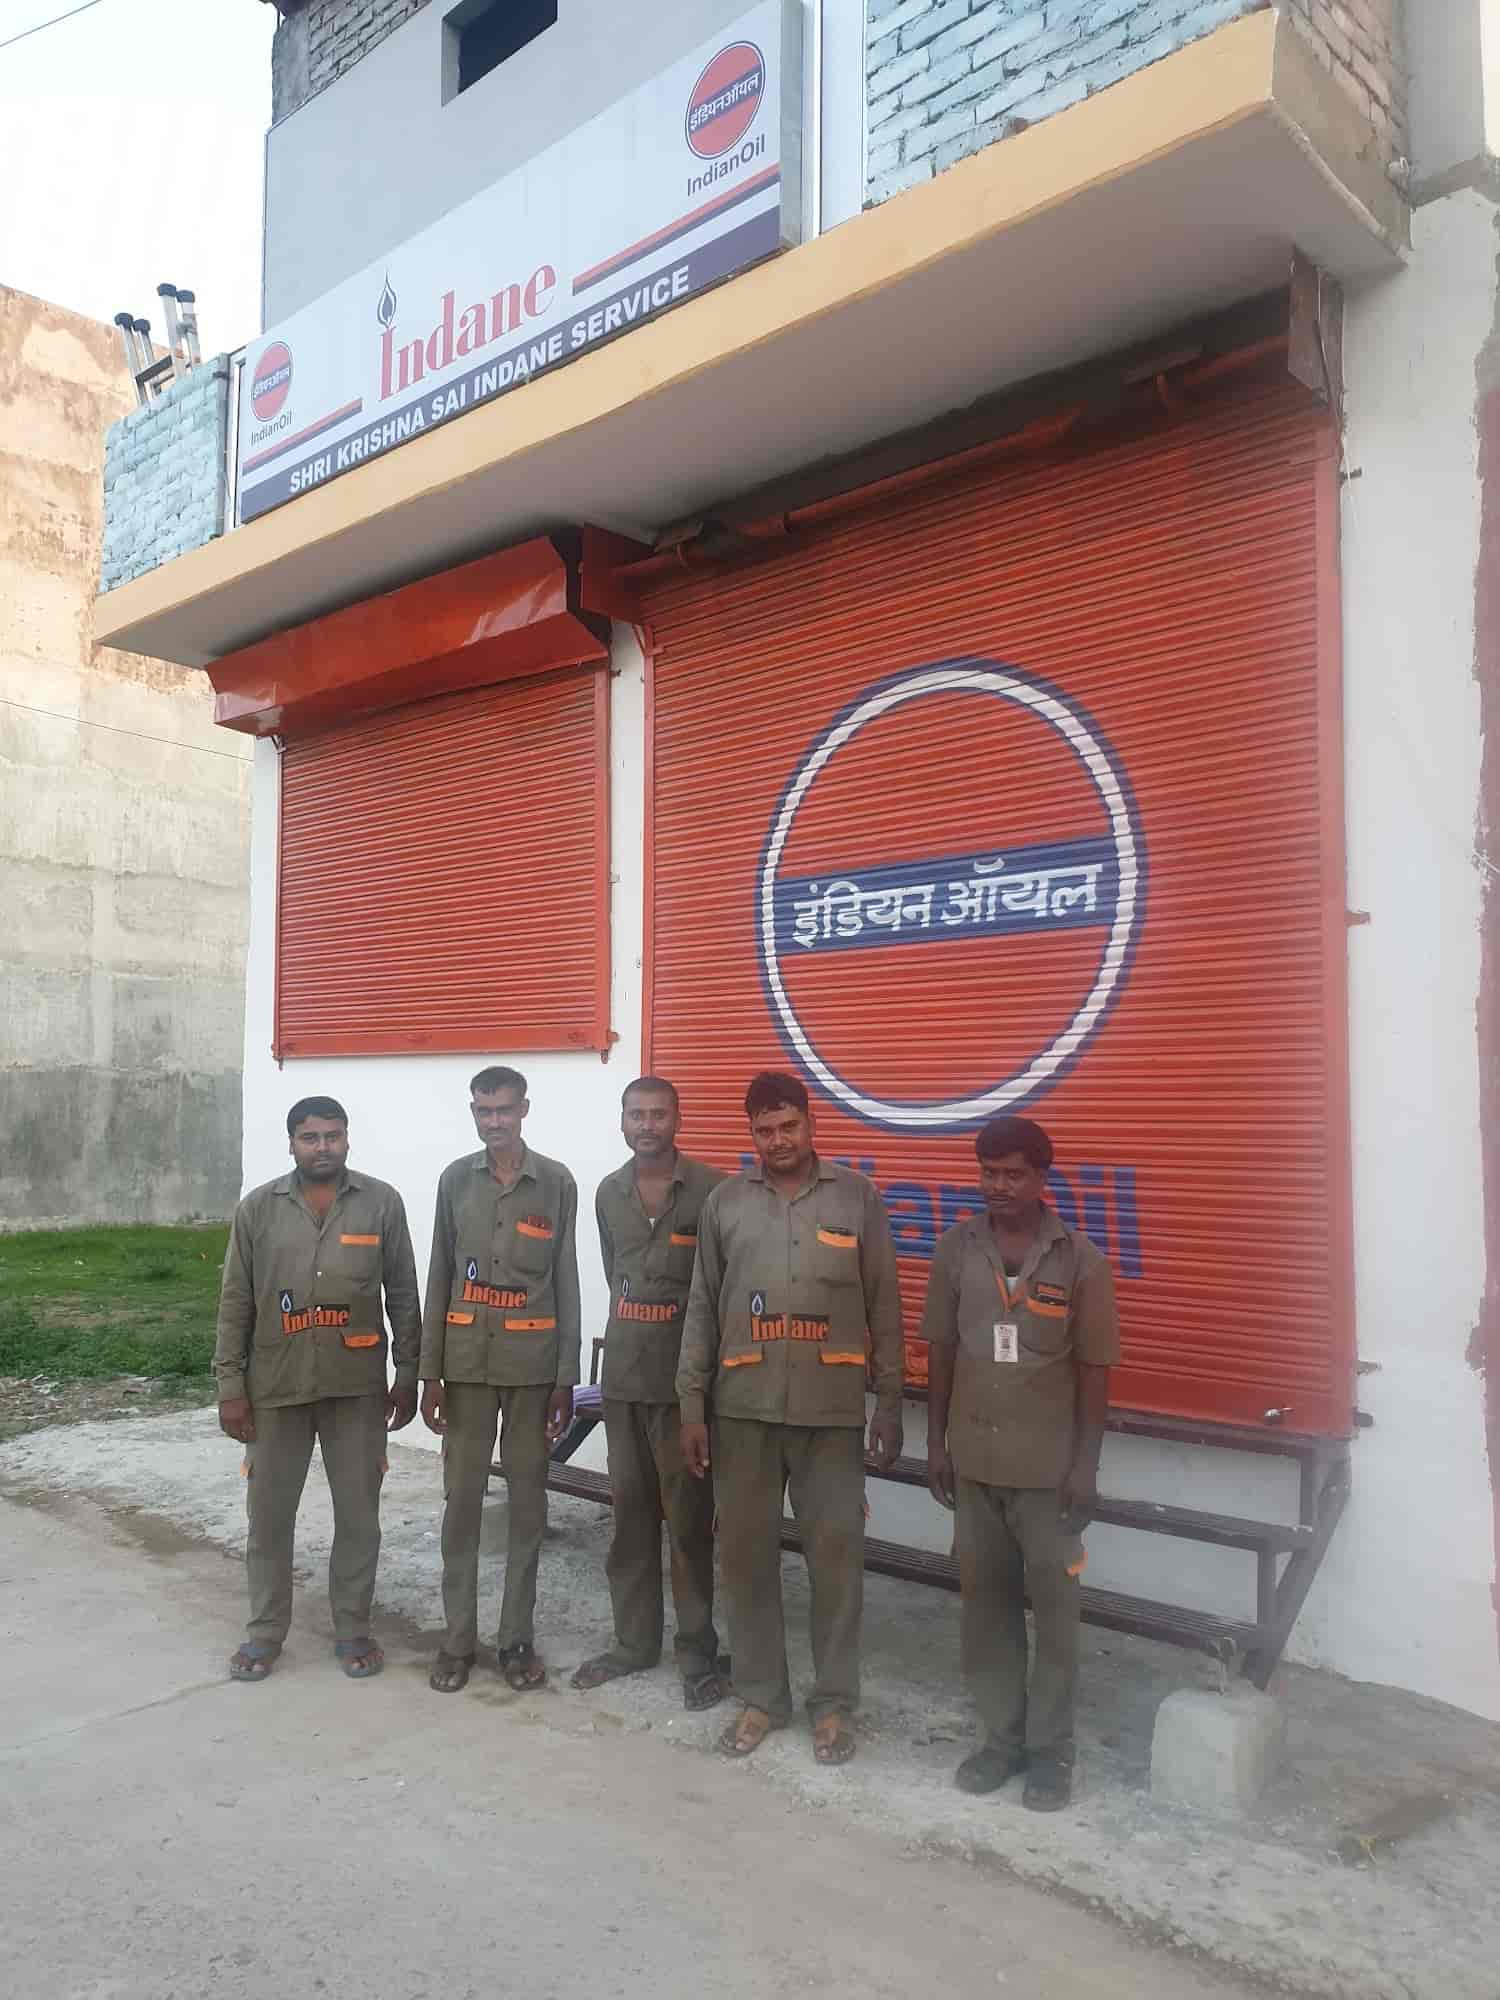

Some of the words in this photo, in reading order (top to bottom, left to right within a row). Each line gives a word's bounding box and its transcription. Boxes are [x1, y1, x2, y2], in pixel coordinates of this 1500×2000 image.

[687, 134, 765, 197] IndianOil
[379, 264, 557, 402] Indane
[289, 455, 331, 493] SHRI
[336, 407, 425, 469] KRISHNA
[431, 384, 465, 421] SAI
[474, 332, 563, 400] INDANE
[571, 265, 689, 350] SERVICE
[250, 410, 292, 446] IndianOil
[793, 881, 935, 948] इंडियन
[752, 1313, 831, 1341] Indane
